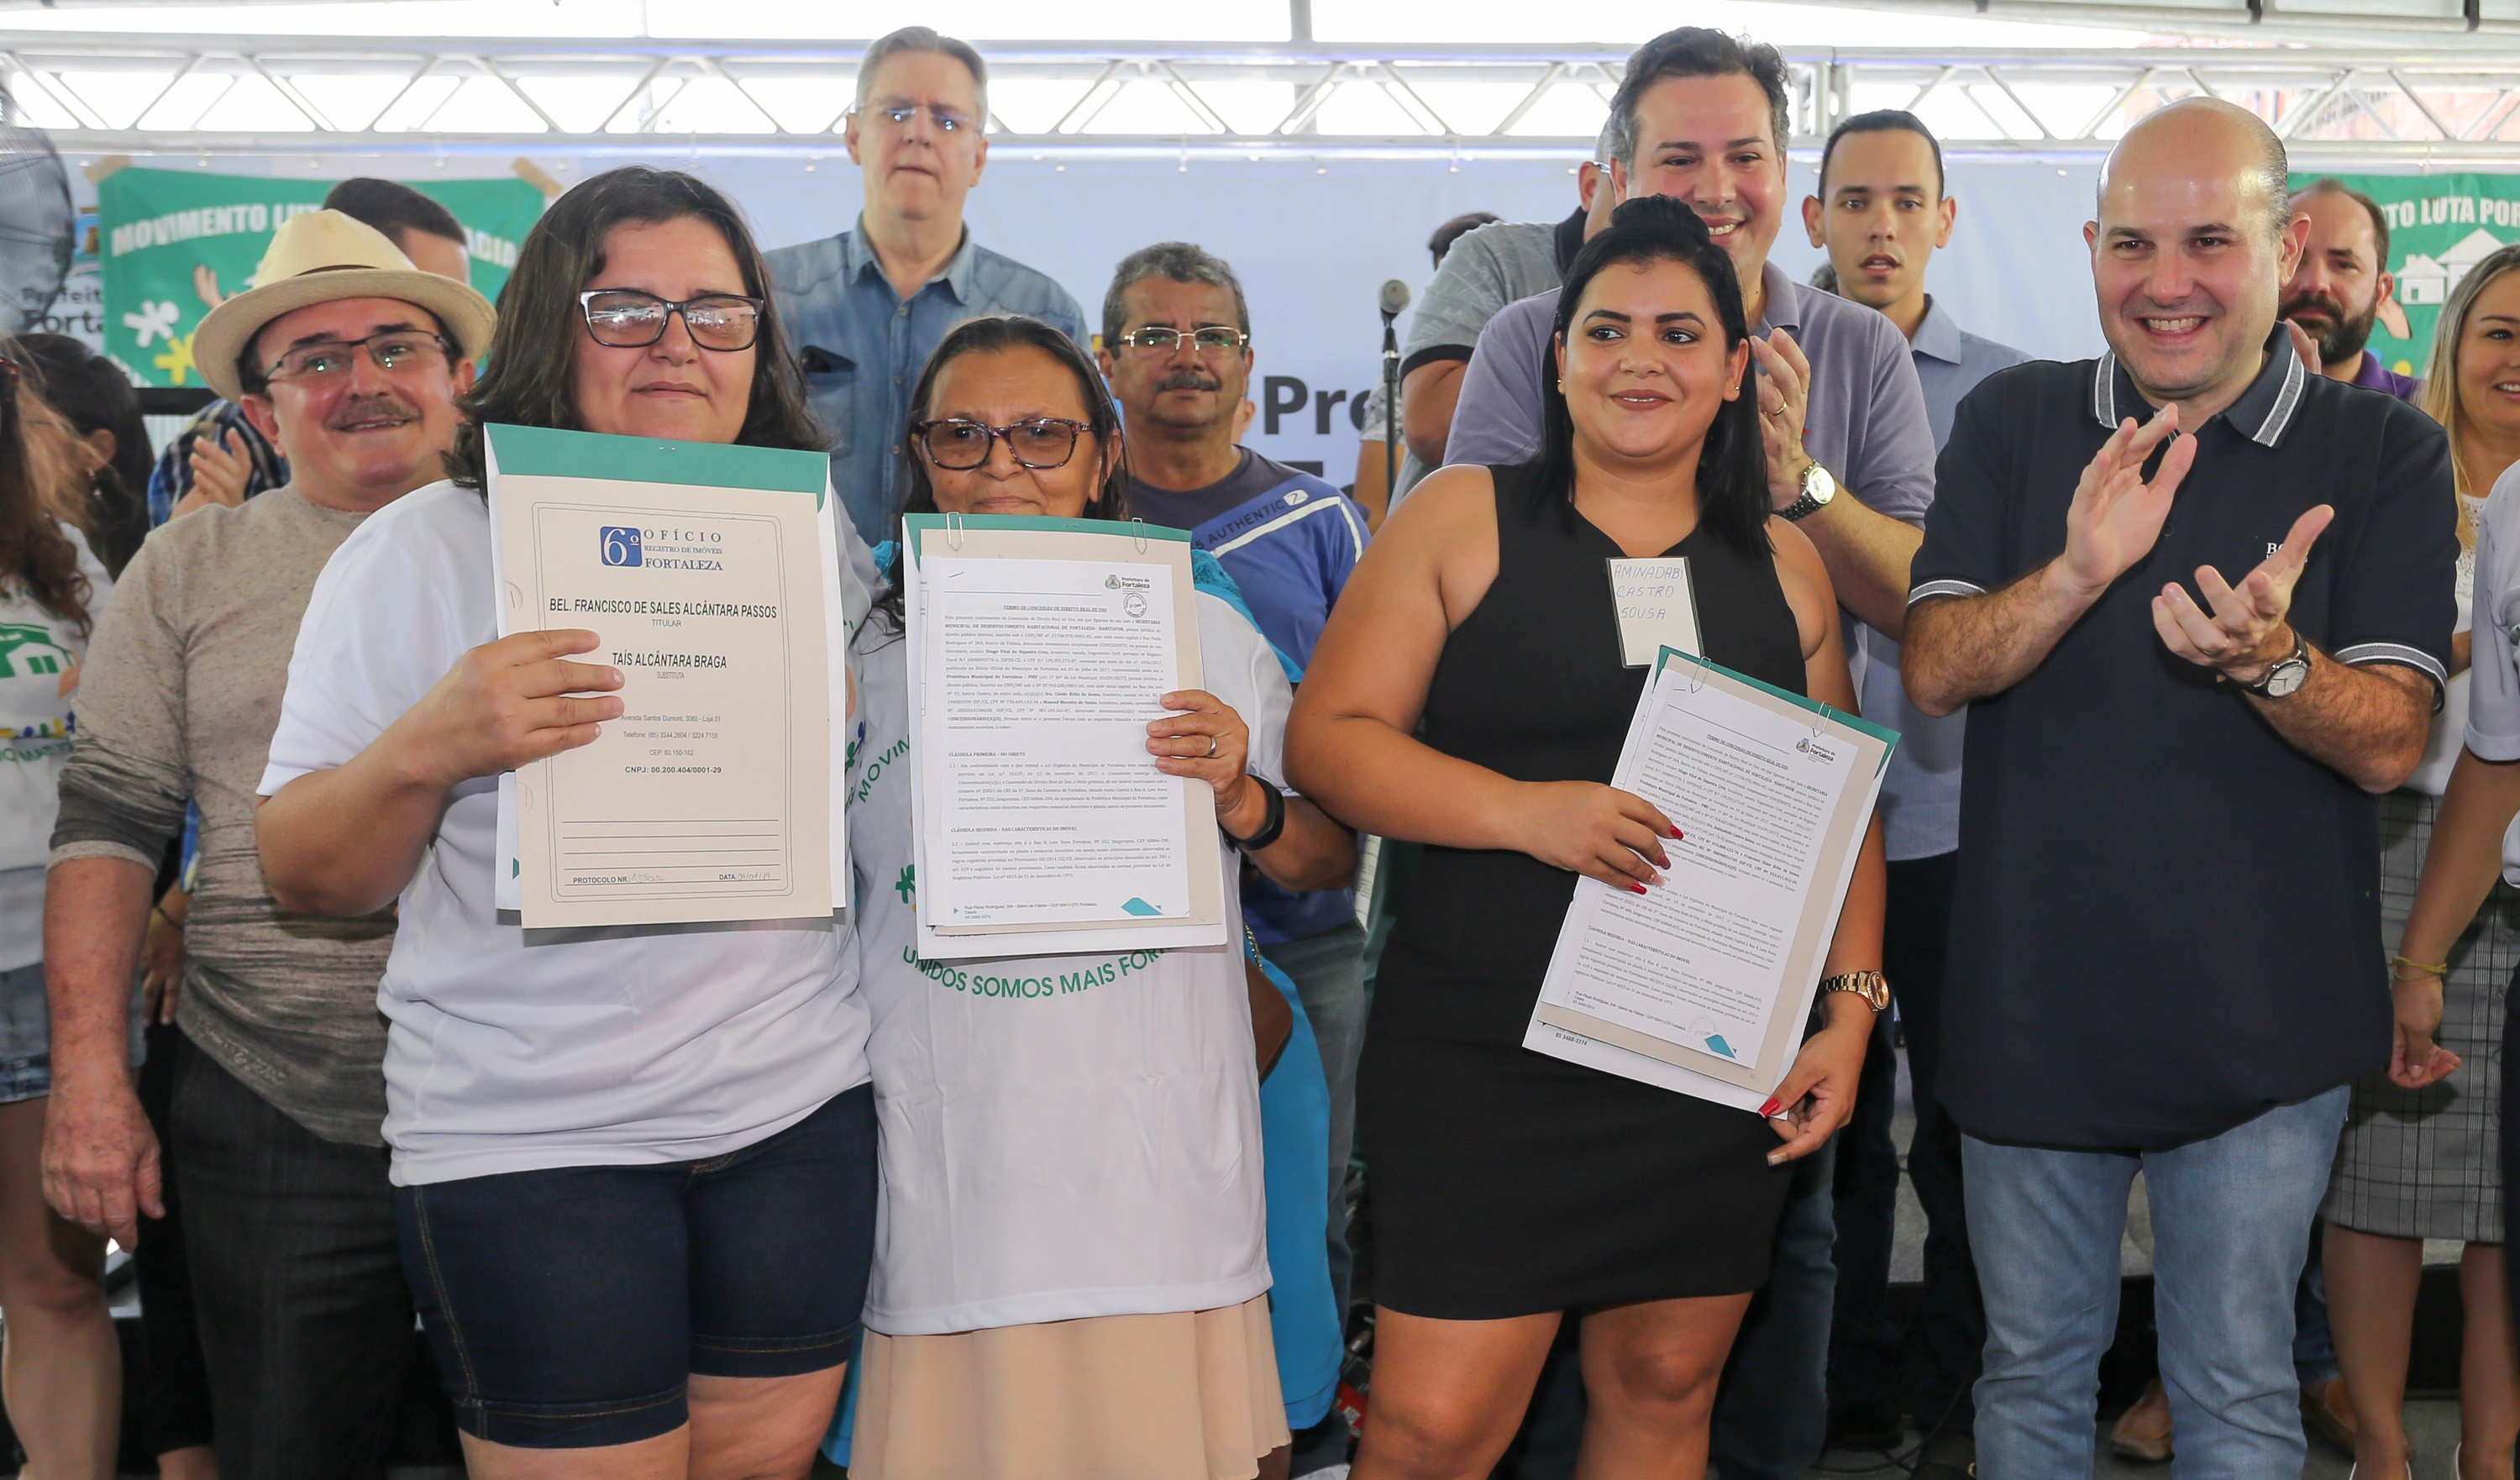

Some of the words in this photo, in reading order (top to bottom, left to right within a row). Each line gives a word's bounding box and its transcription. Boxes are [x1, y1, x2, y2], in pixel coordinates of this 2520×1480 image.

[2421, 196, 2475, 225] LUTA
[112, 204, 268, 256] MOVIMENTO
[1208, 499, 1285, 544] AUTHENTIC
[643, 528, 722, 543] OFÍCIO
[645, 558, 722, 571] FORTALEZA
[1616, 585, 1674, 598] CASTRO
[549, 598, 572, 611] BEL.
[575, 599, 632, 614] FRANCISCO
[633, 601, 648, 614] DE
[649, 601, 681, 615] SALES
[683, 601, 739, 617] ALCÂNTARA
[741, 605, 777, 618] PASSOS
[1620, 606, 1667, 620] SOUSA
[651, 619, 682, 627] TITULAR
[612, 650, 633, 666] TAÍS
[634, 651, 692, 668] ALCÂNTARA
[694, 655, 727, 669] BRAGA
[657, 671, 685, 680] SUBSTITUTA
[1810, 748, 1834, 761] Fortaleza
[573, 877, 617, 885] PROTOCOLO
[719, 874, 738, 882] DATA:
[902, 945, 968, 992] UNIDOS
[972, 975, 1053, 999] SOMOS
[1059, 963, 1116, 995] MAIS
[1118, 948, 1169, 977] FOR
[1562, 1035, 1587, 1045] 3488-3374
